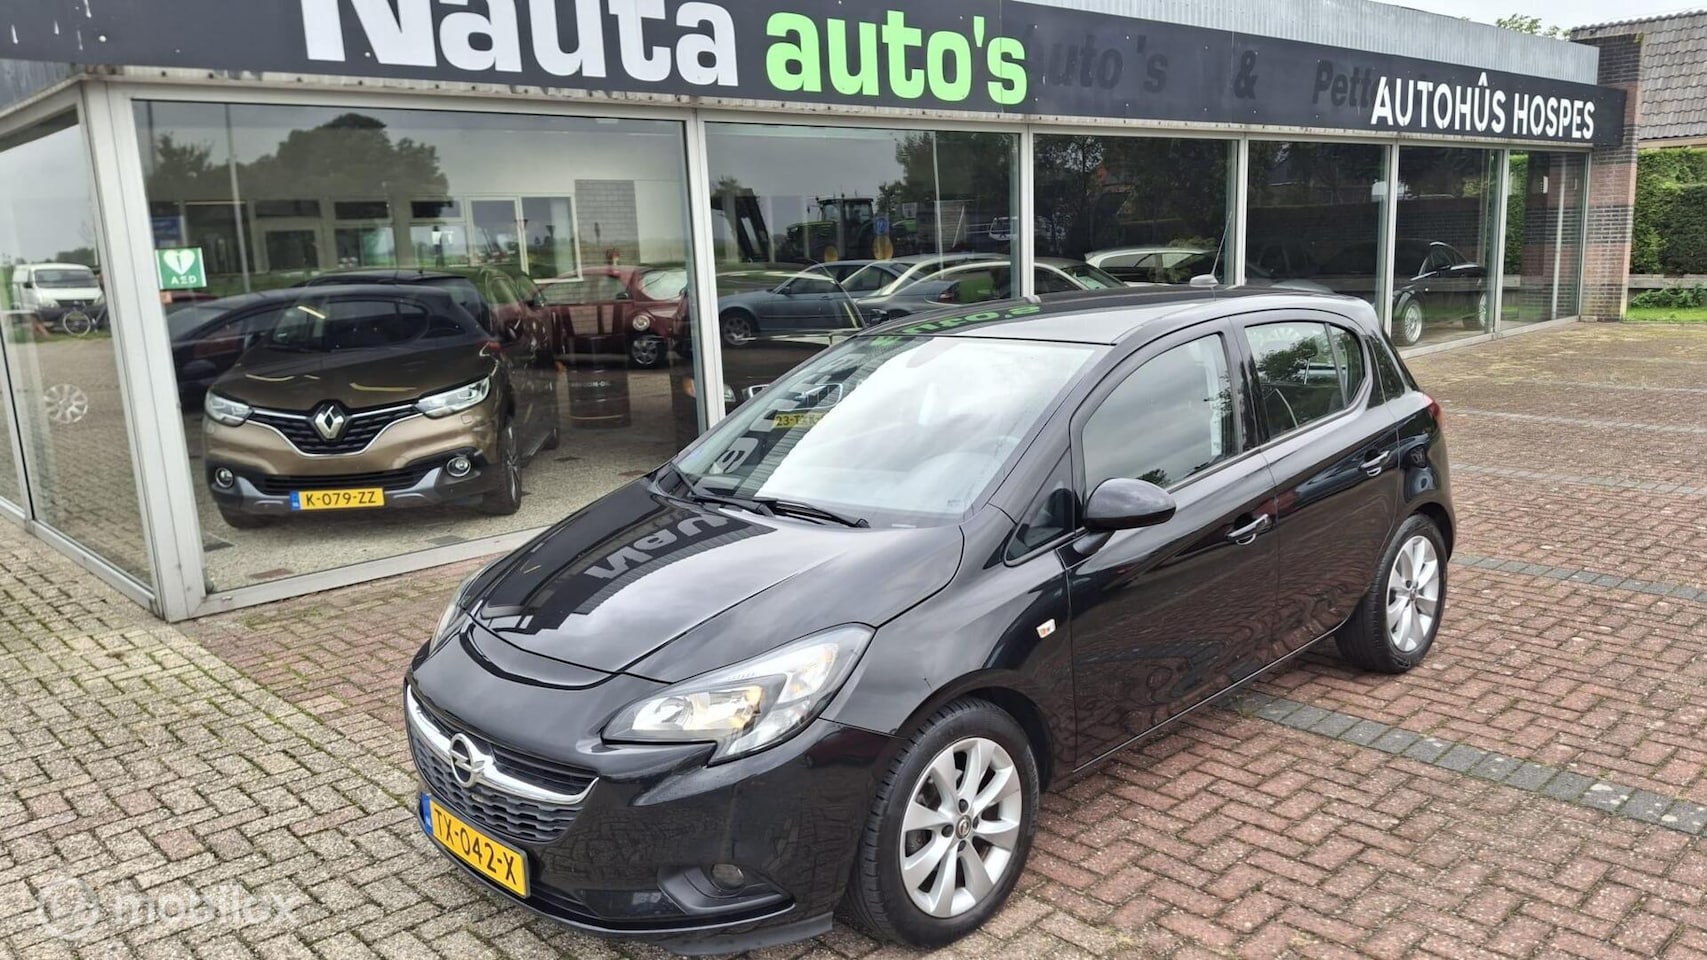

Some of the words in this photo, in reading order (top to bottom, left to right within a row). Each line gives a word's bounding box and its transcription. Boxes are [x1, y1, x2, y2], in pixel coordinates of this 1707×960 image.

[300, 0, 740, 87] Nauta
[765, 10, 1028, 105] auto's
[1370, 71, 1506, 133] AUTOHÛS
[1512, 92, 1595, 139] HOSPES
[171, 275, 197, 285] AED
[305, 491, 377, 507] K-079-ZZ
[434, 807, 518, 886] TX-042-X
